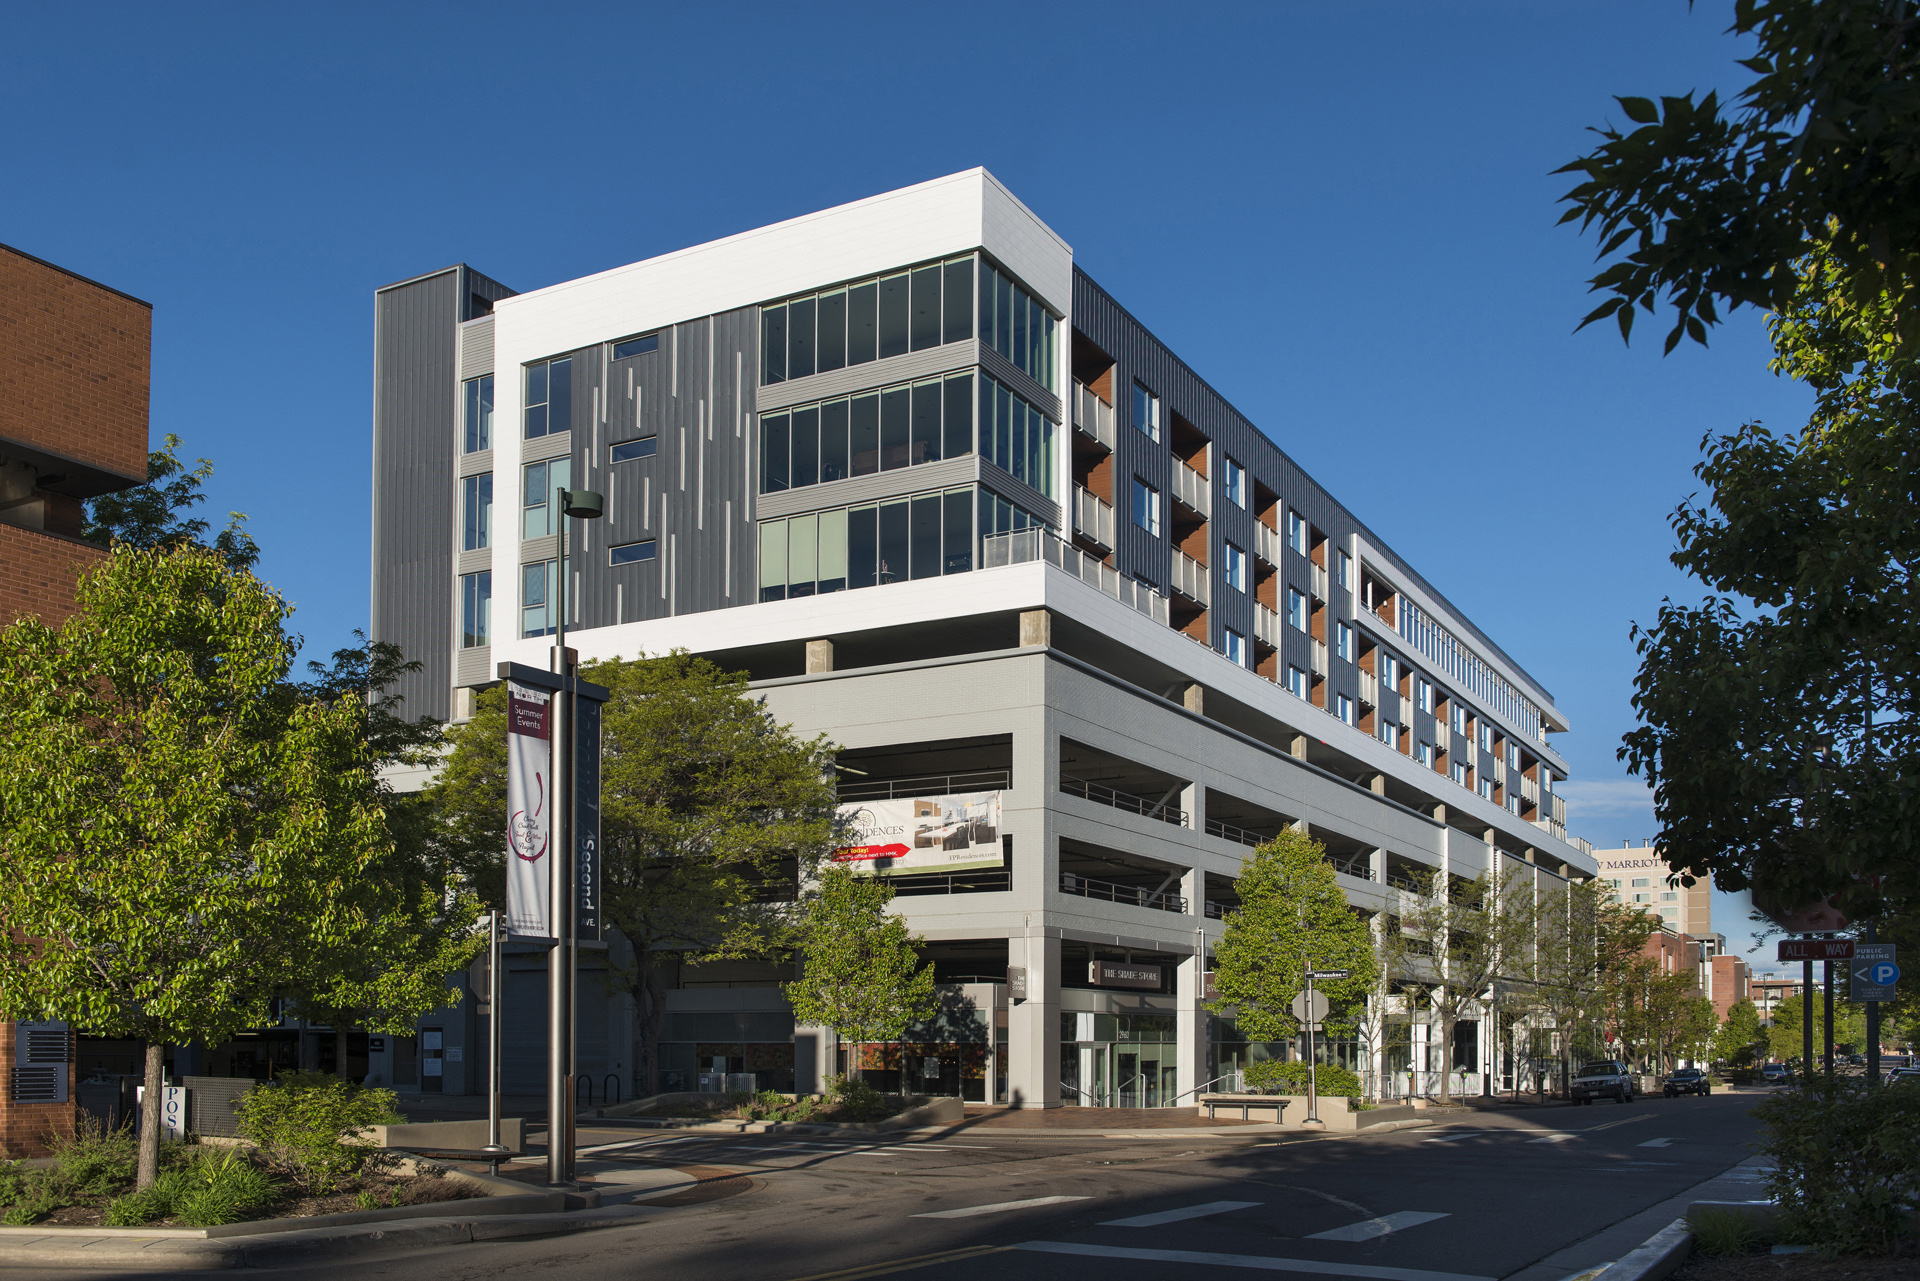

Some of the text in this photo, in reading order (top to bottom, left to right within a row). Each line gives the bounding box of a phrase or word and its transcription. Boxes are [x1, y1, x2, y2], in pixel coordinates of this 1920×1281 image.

[516, 692, 543, 702] NORTH
[514, 704, 544, 719] Summer
[517, 715, 541, 730] Events
[581, 839, 595, 910] Second
[581, 918, 595, 926] AVE.
[1785, 943, 1849, 957] ALL WAY
[1104, 968, 1158, 981] THE SHADE STORE
[1878, 966, 1894, 982] P
[167, 1087, 178, 1140] POST
